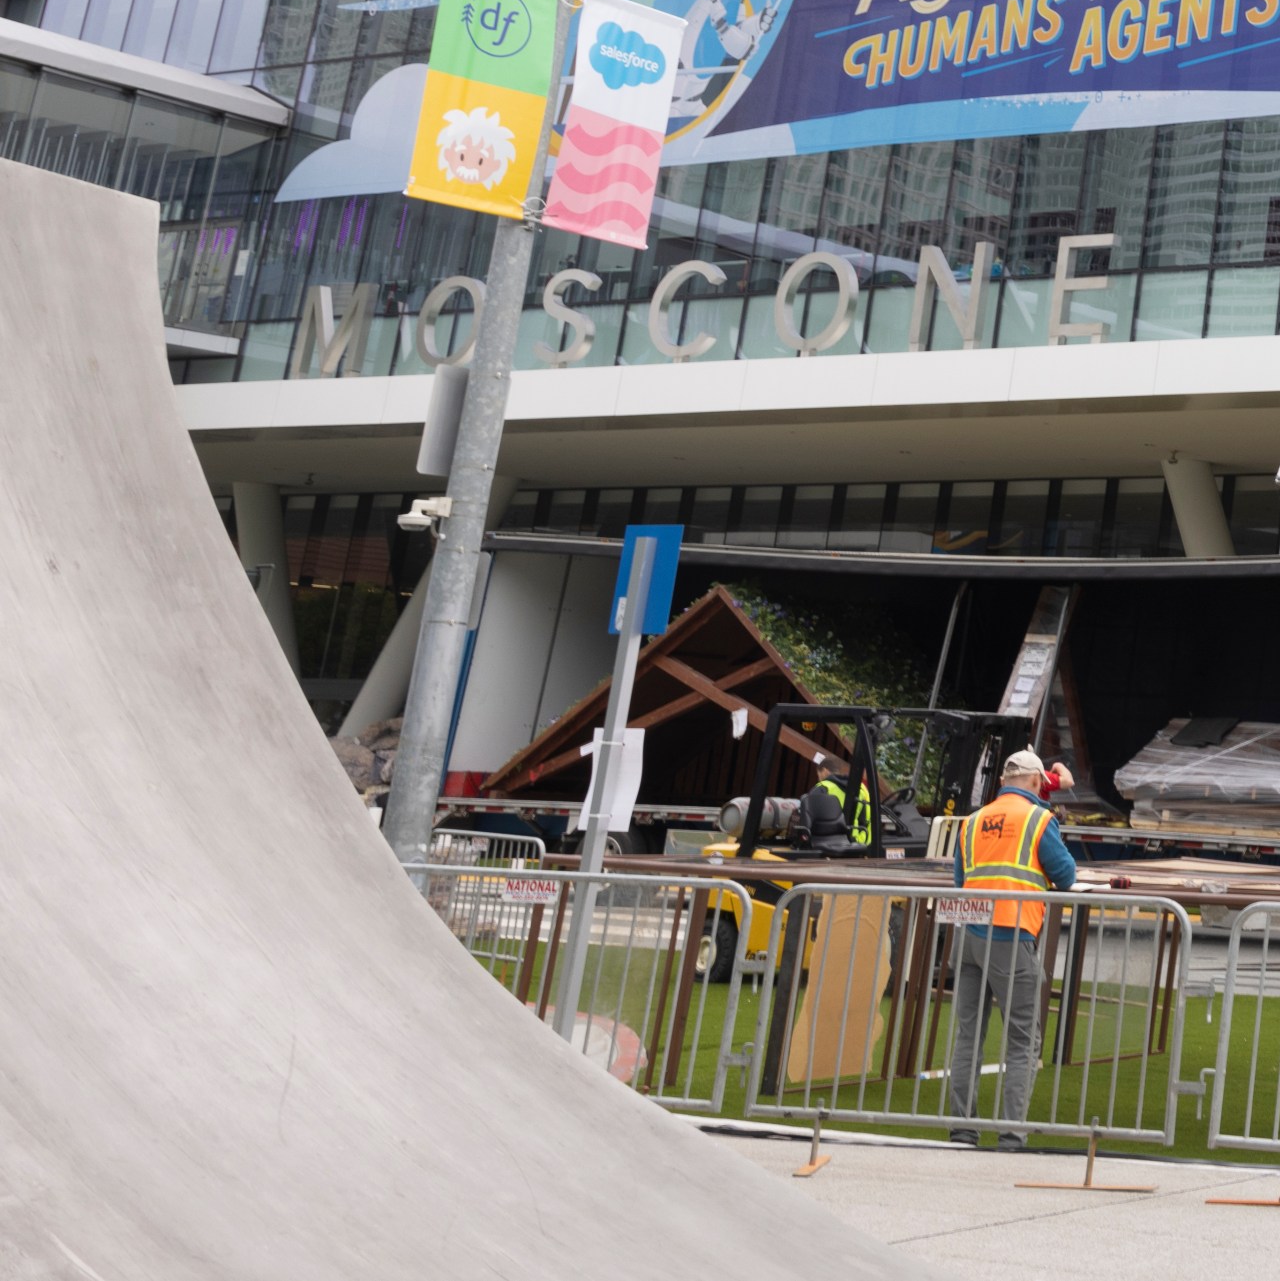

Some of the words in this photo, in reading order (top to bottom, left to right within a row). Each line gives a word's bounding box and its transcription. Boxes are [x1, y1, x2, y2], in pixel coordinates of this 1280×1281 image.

[599, 43, 660, 74] salesforce
[287, 232, 1118, 378] MOSCONE
[507, 879, 557, 893] NATIONAL
[940, 900, 991, 913] NATIONAL
